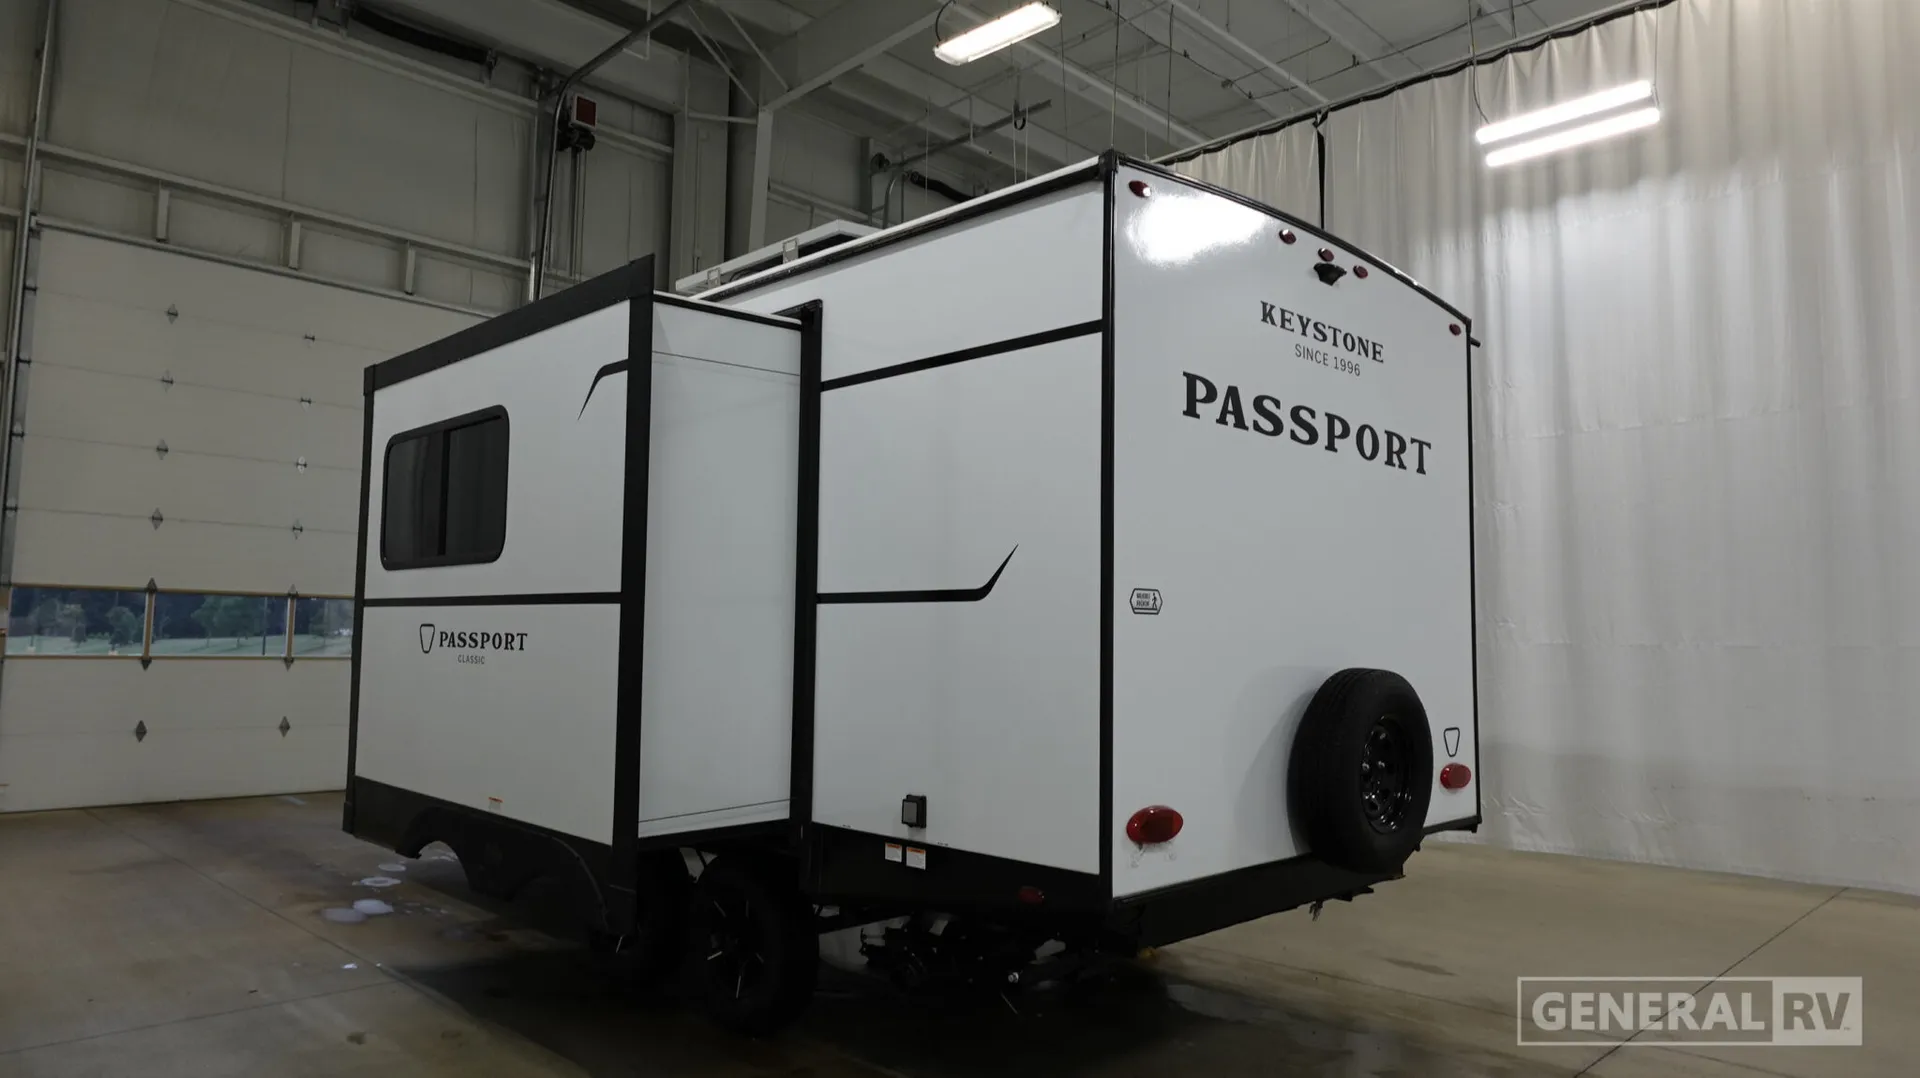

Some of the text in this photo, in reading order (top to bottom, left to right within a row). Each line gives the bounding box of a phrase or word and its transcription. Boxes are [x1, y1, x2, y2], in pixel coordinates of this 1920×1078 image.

[1260, 300, 1384, 364] KEYSTONE
[1294, 343, 1361, 377] SINCE 1996
[1182, 371, 1432, 475] PASSPORT
[439, 631, 528, 651] PASSPORT
[457, 654, 486, 665] CLASSIC
